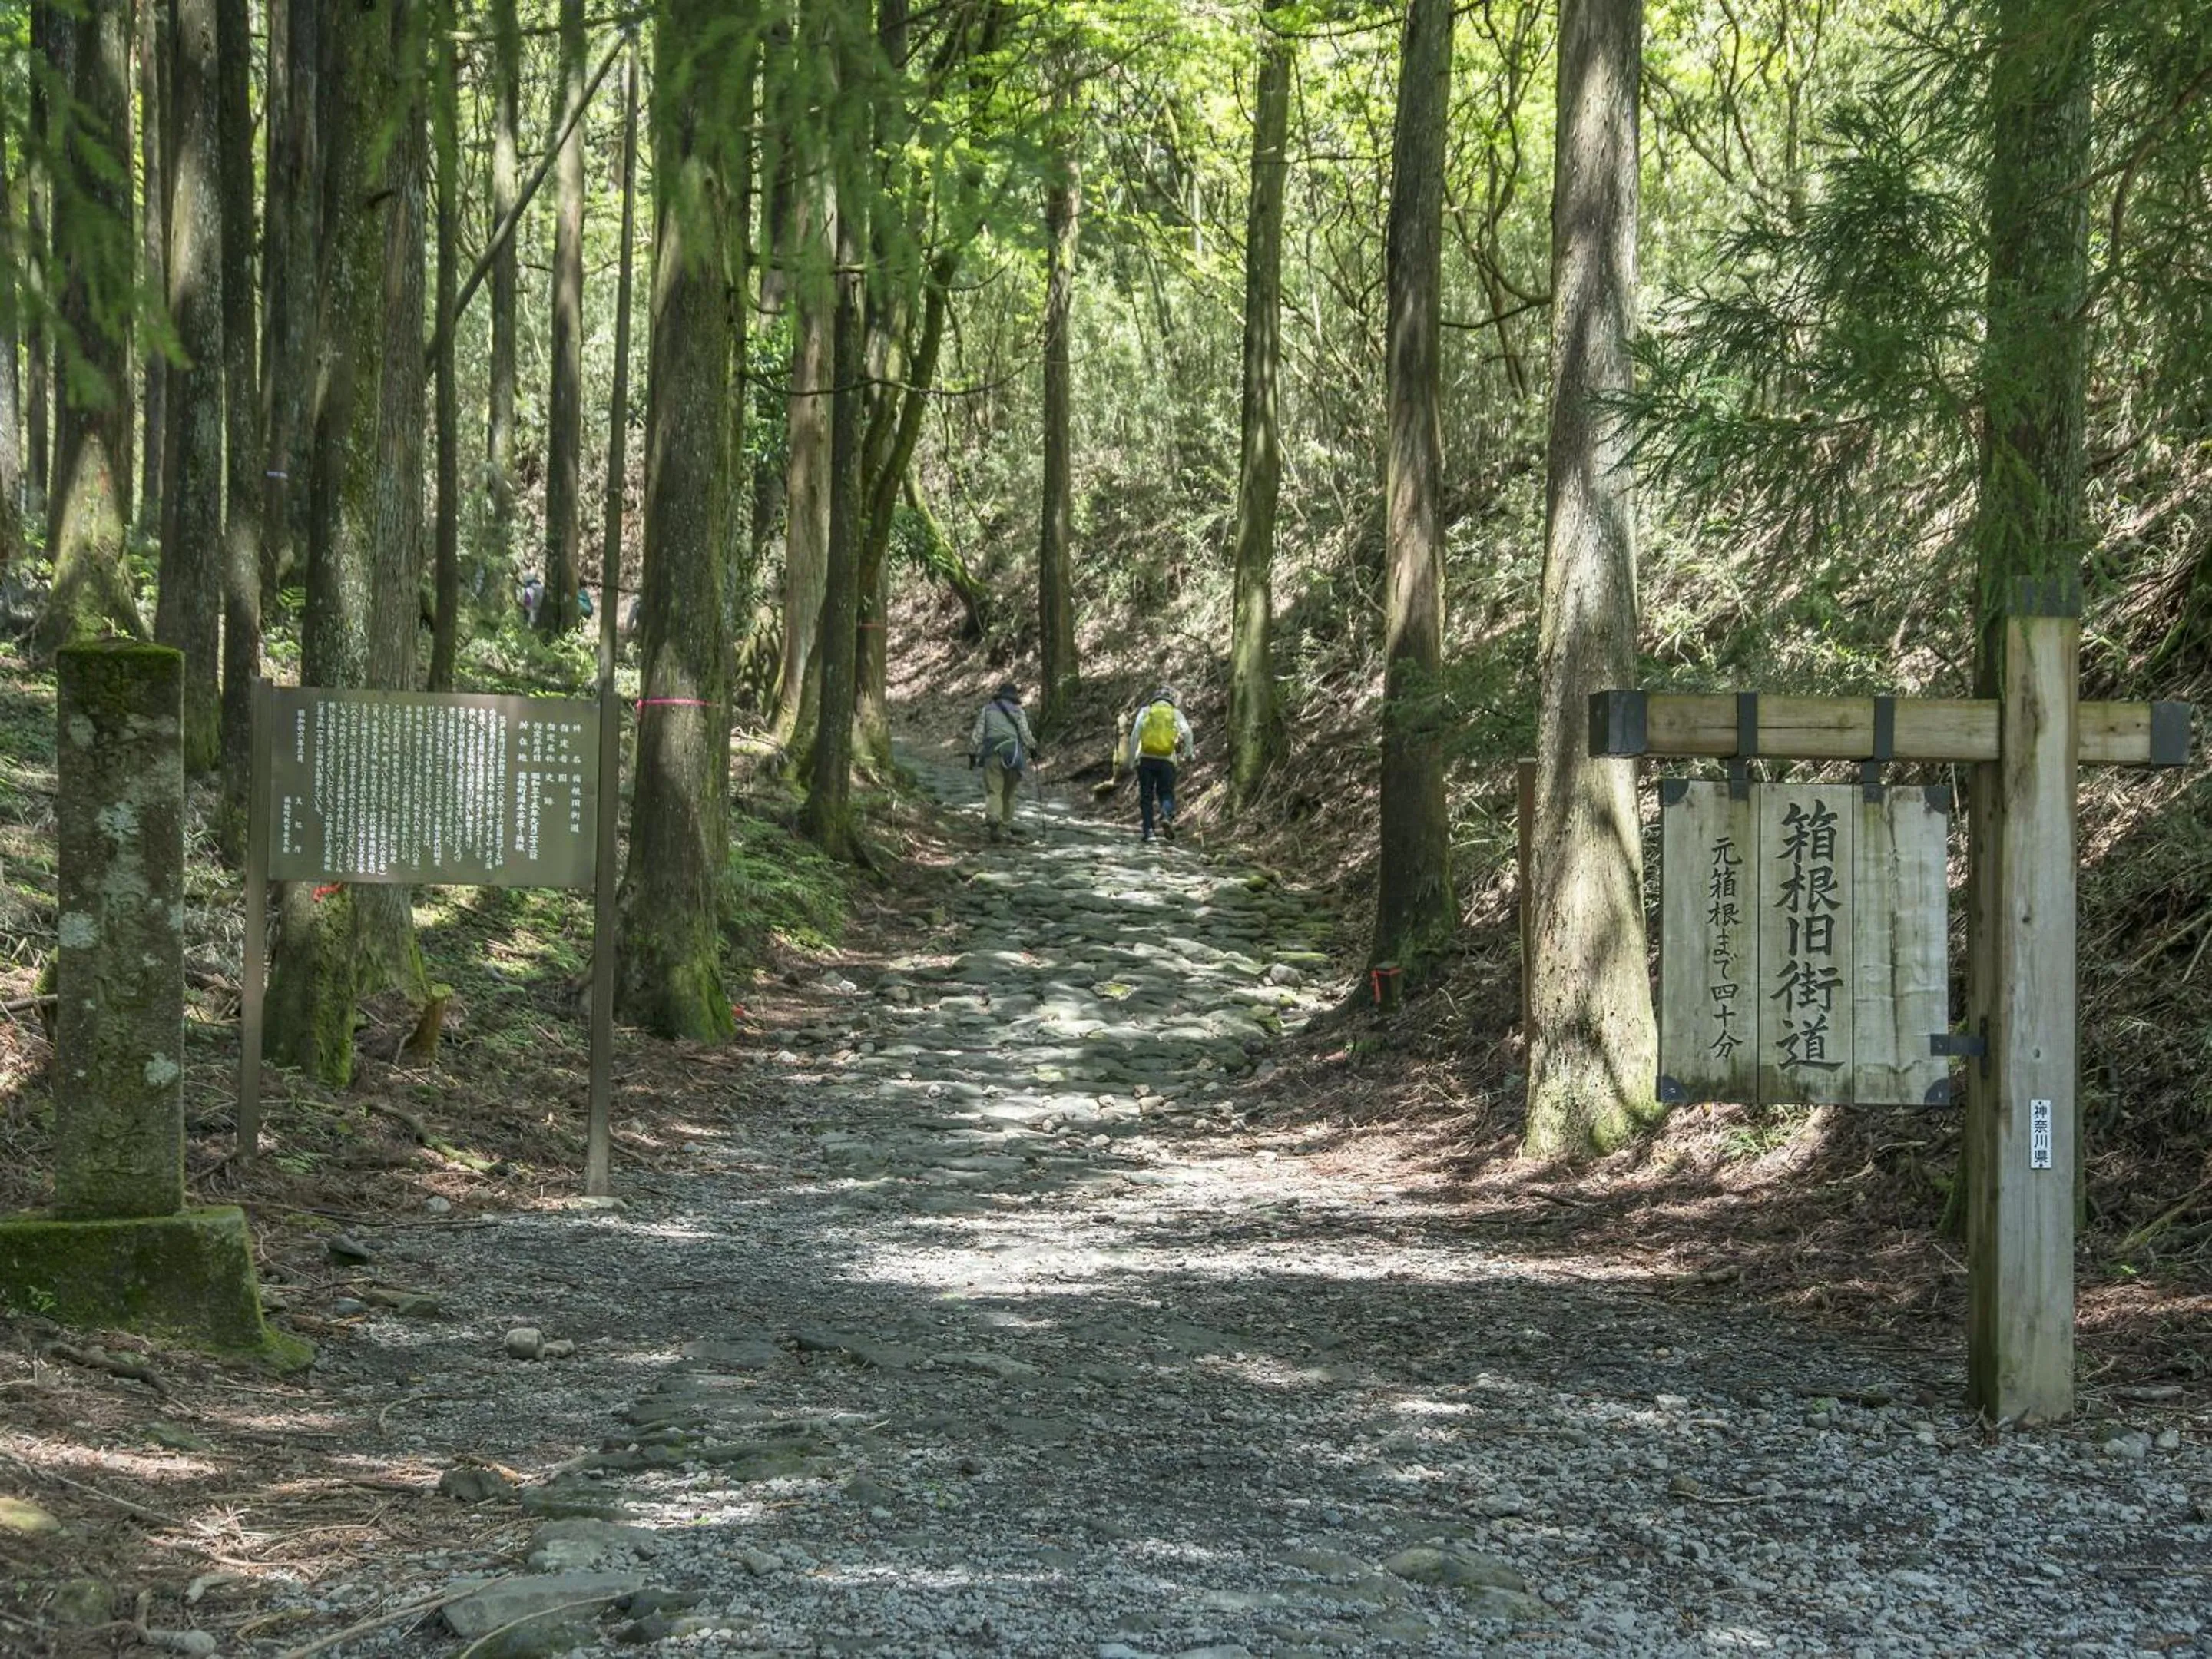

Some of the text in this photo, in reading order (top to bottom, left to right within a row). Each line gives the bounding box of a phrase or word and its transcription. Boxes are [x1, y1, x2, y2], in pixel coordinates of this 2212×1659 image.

[1706, 836, 1743, 1059] 元箱根まで四十分
[1770, 798, 1845, 1074] 箱根旧街道
[2034, 1105, 2048, 1163] 神奈川県
